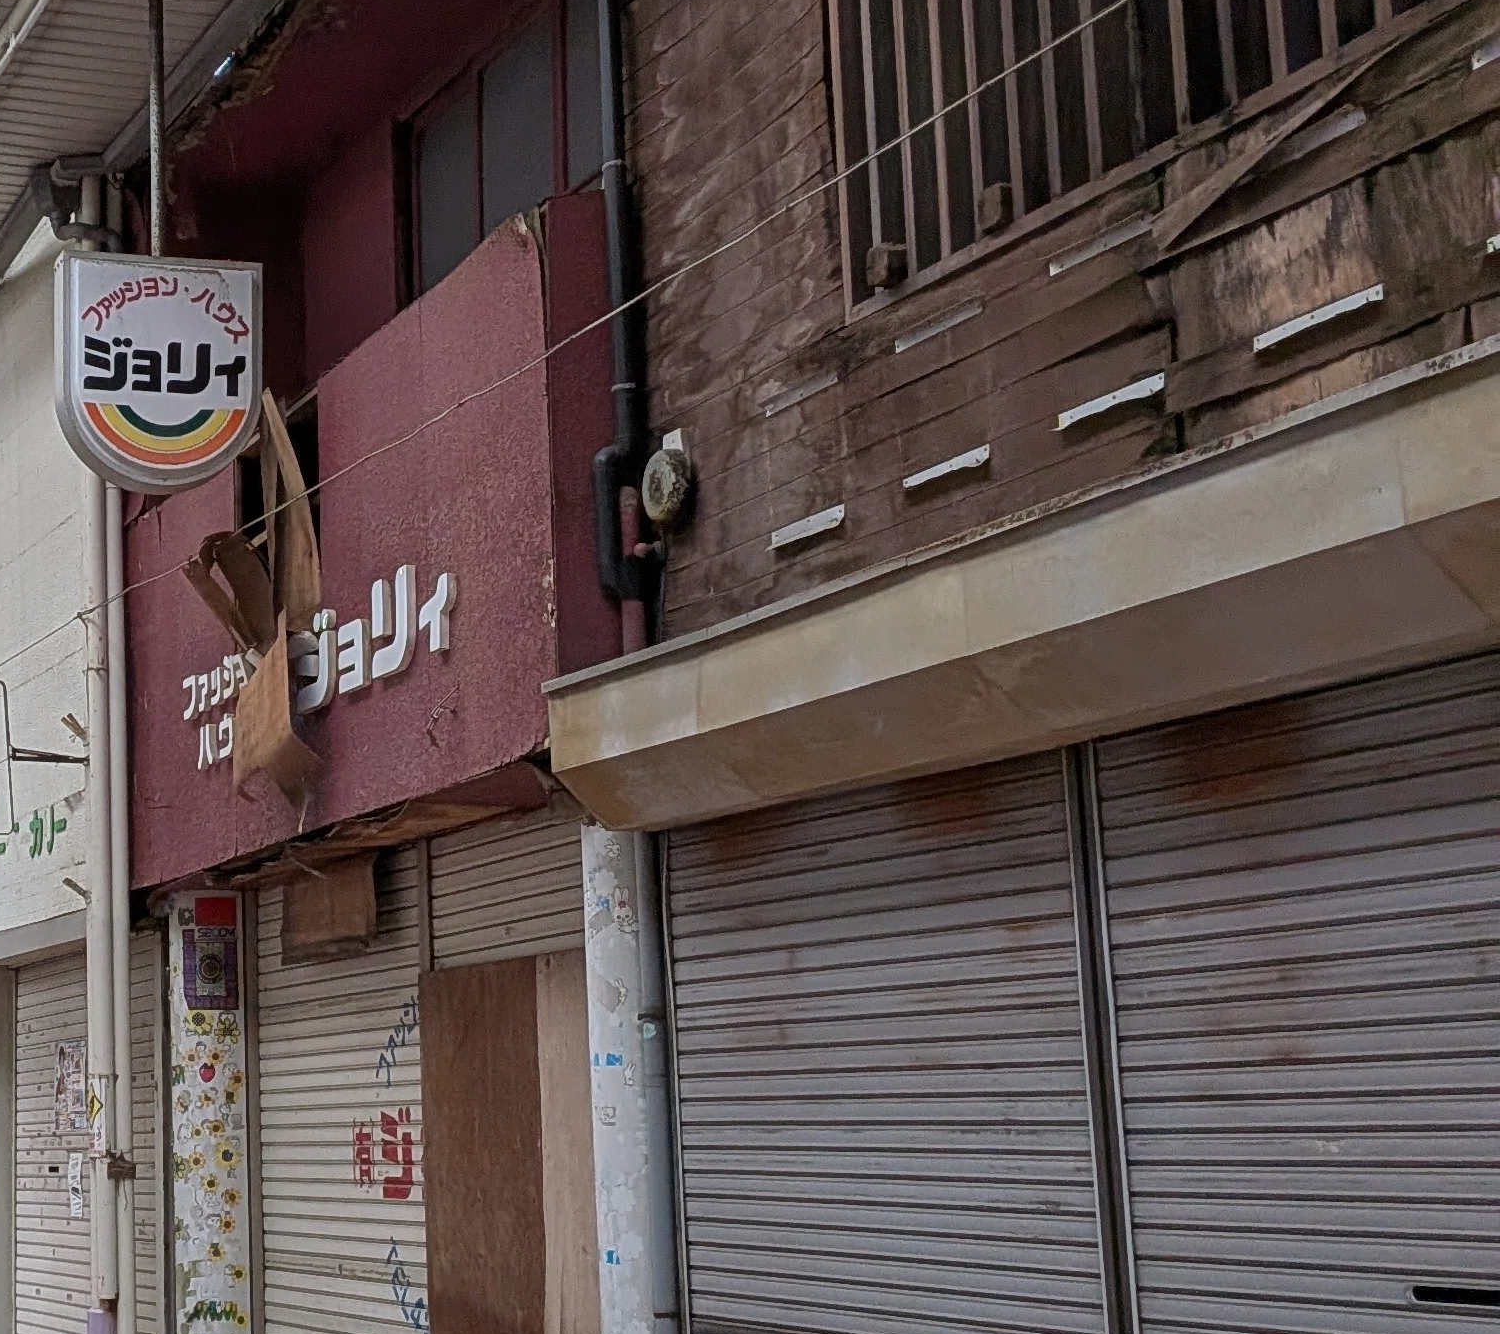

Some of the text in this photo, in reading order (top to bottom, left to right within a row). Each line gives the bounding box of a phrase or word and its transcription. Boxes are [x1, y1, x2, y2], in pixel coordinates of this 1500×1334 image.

[83, 335, 247, 398] ジョリィ
[182, 648, 264, 720] ファッショ
